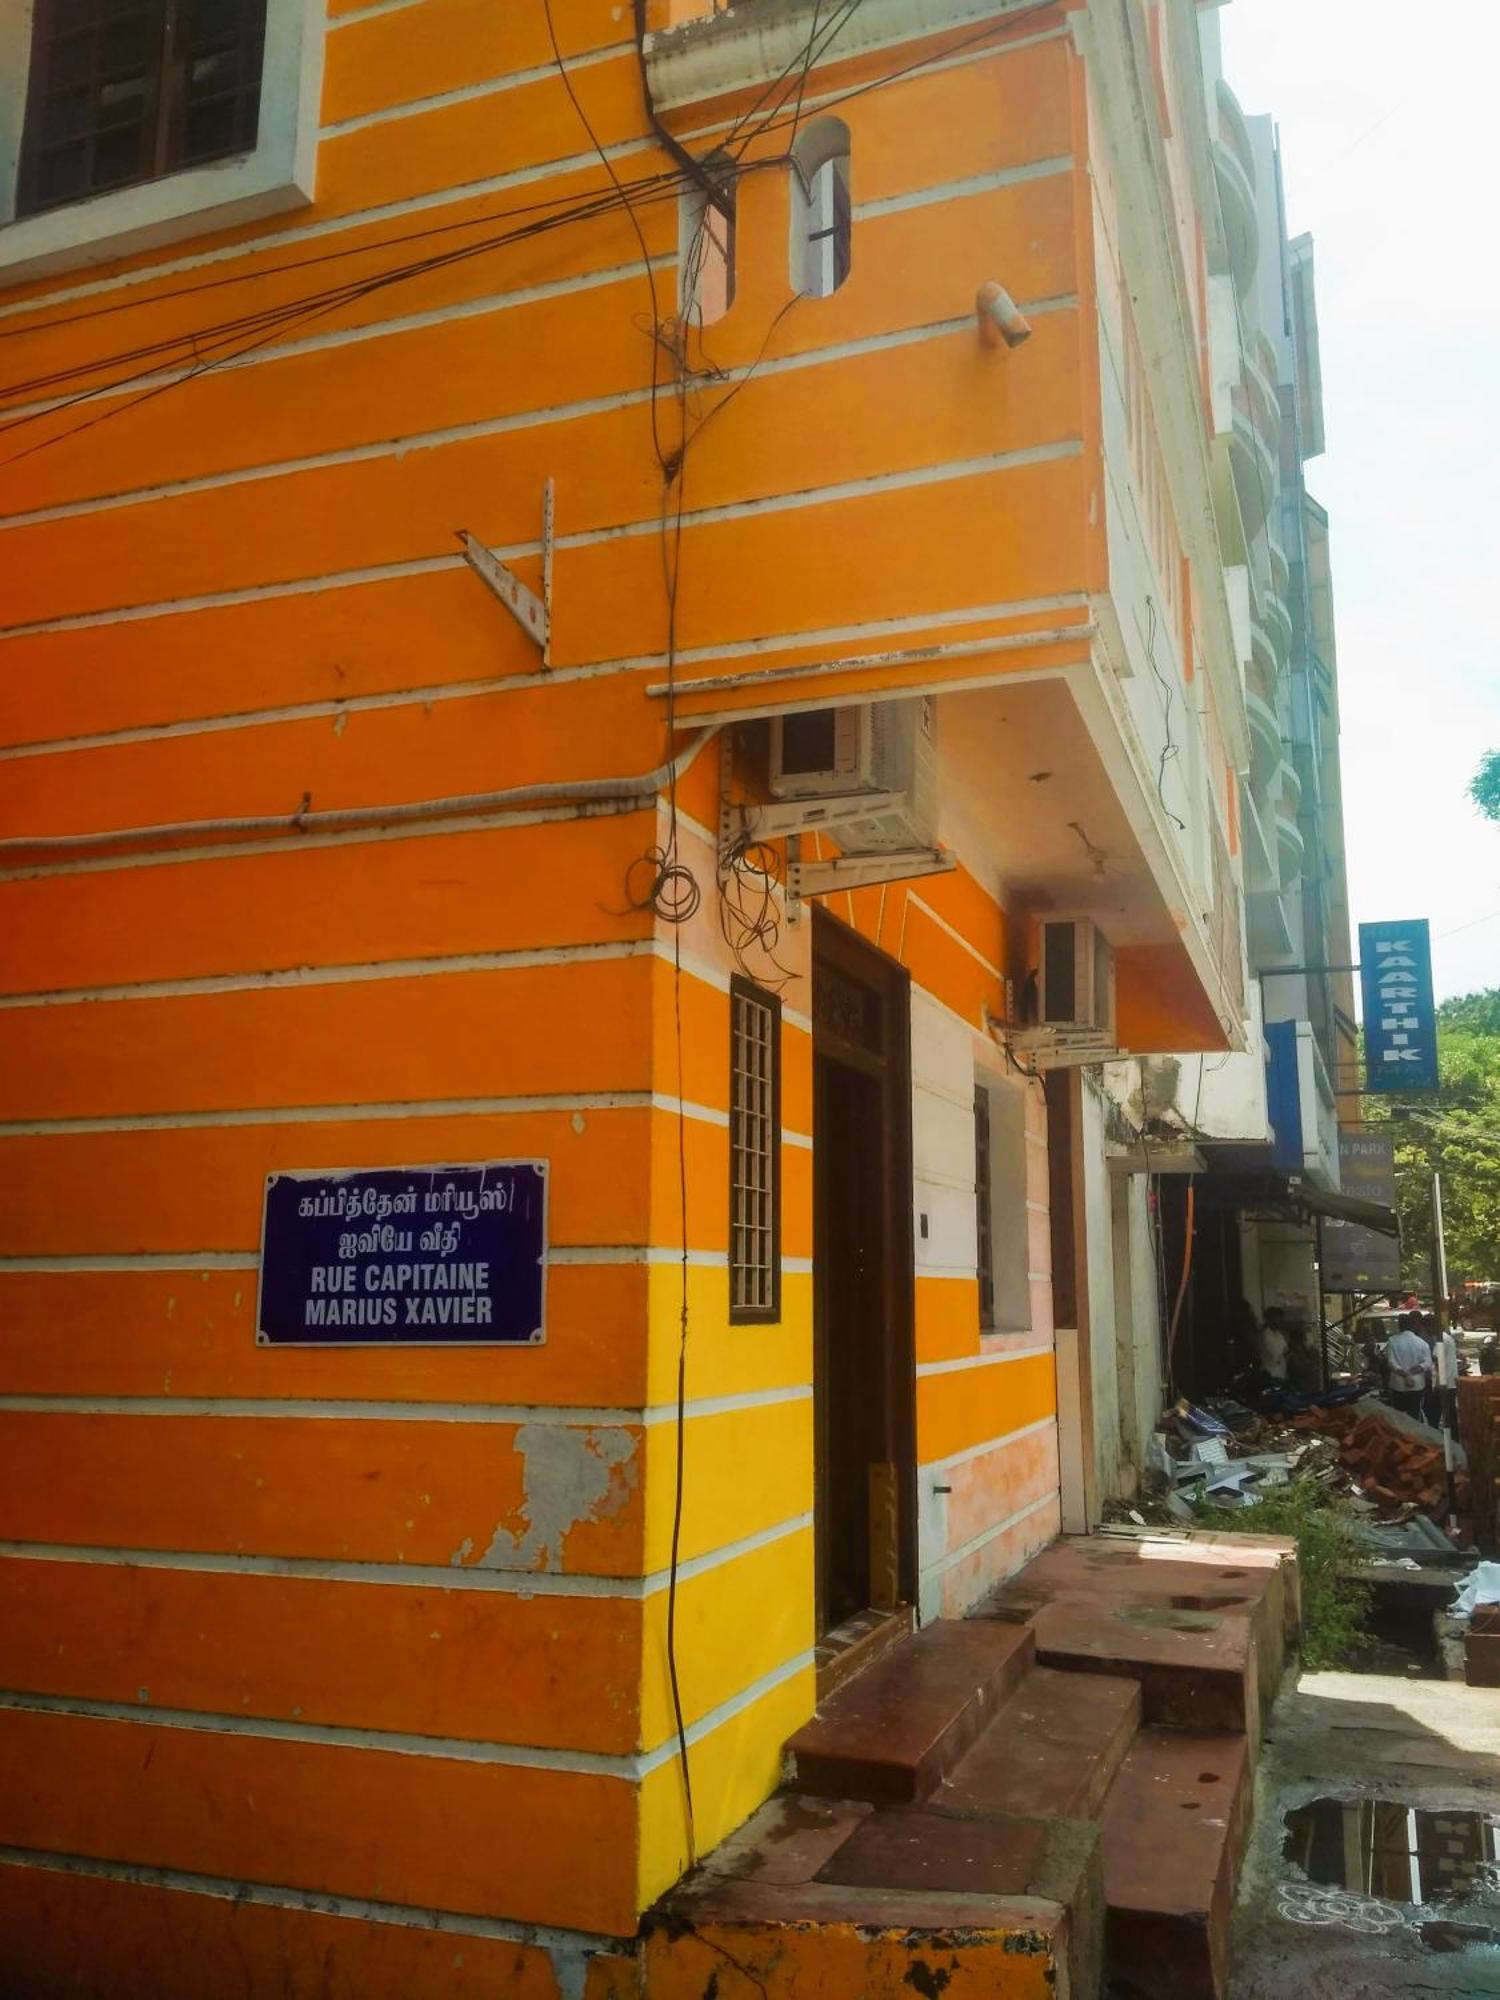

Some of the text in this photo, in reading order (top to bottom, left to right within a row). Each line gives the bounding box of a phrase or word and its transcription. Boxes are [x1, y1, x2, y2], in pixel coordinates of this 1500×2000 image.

[1375, 940, 1422, 1062] KAARTHIK
[420, 1222, 461, 1256] வீதி
[311, 1263, 489, 1292] RUE CAPITAINE
[305, 1297, 492, 1325] MARIUS XAVIER
